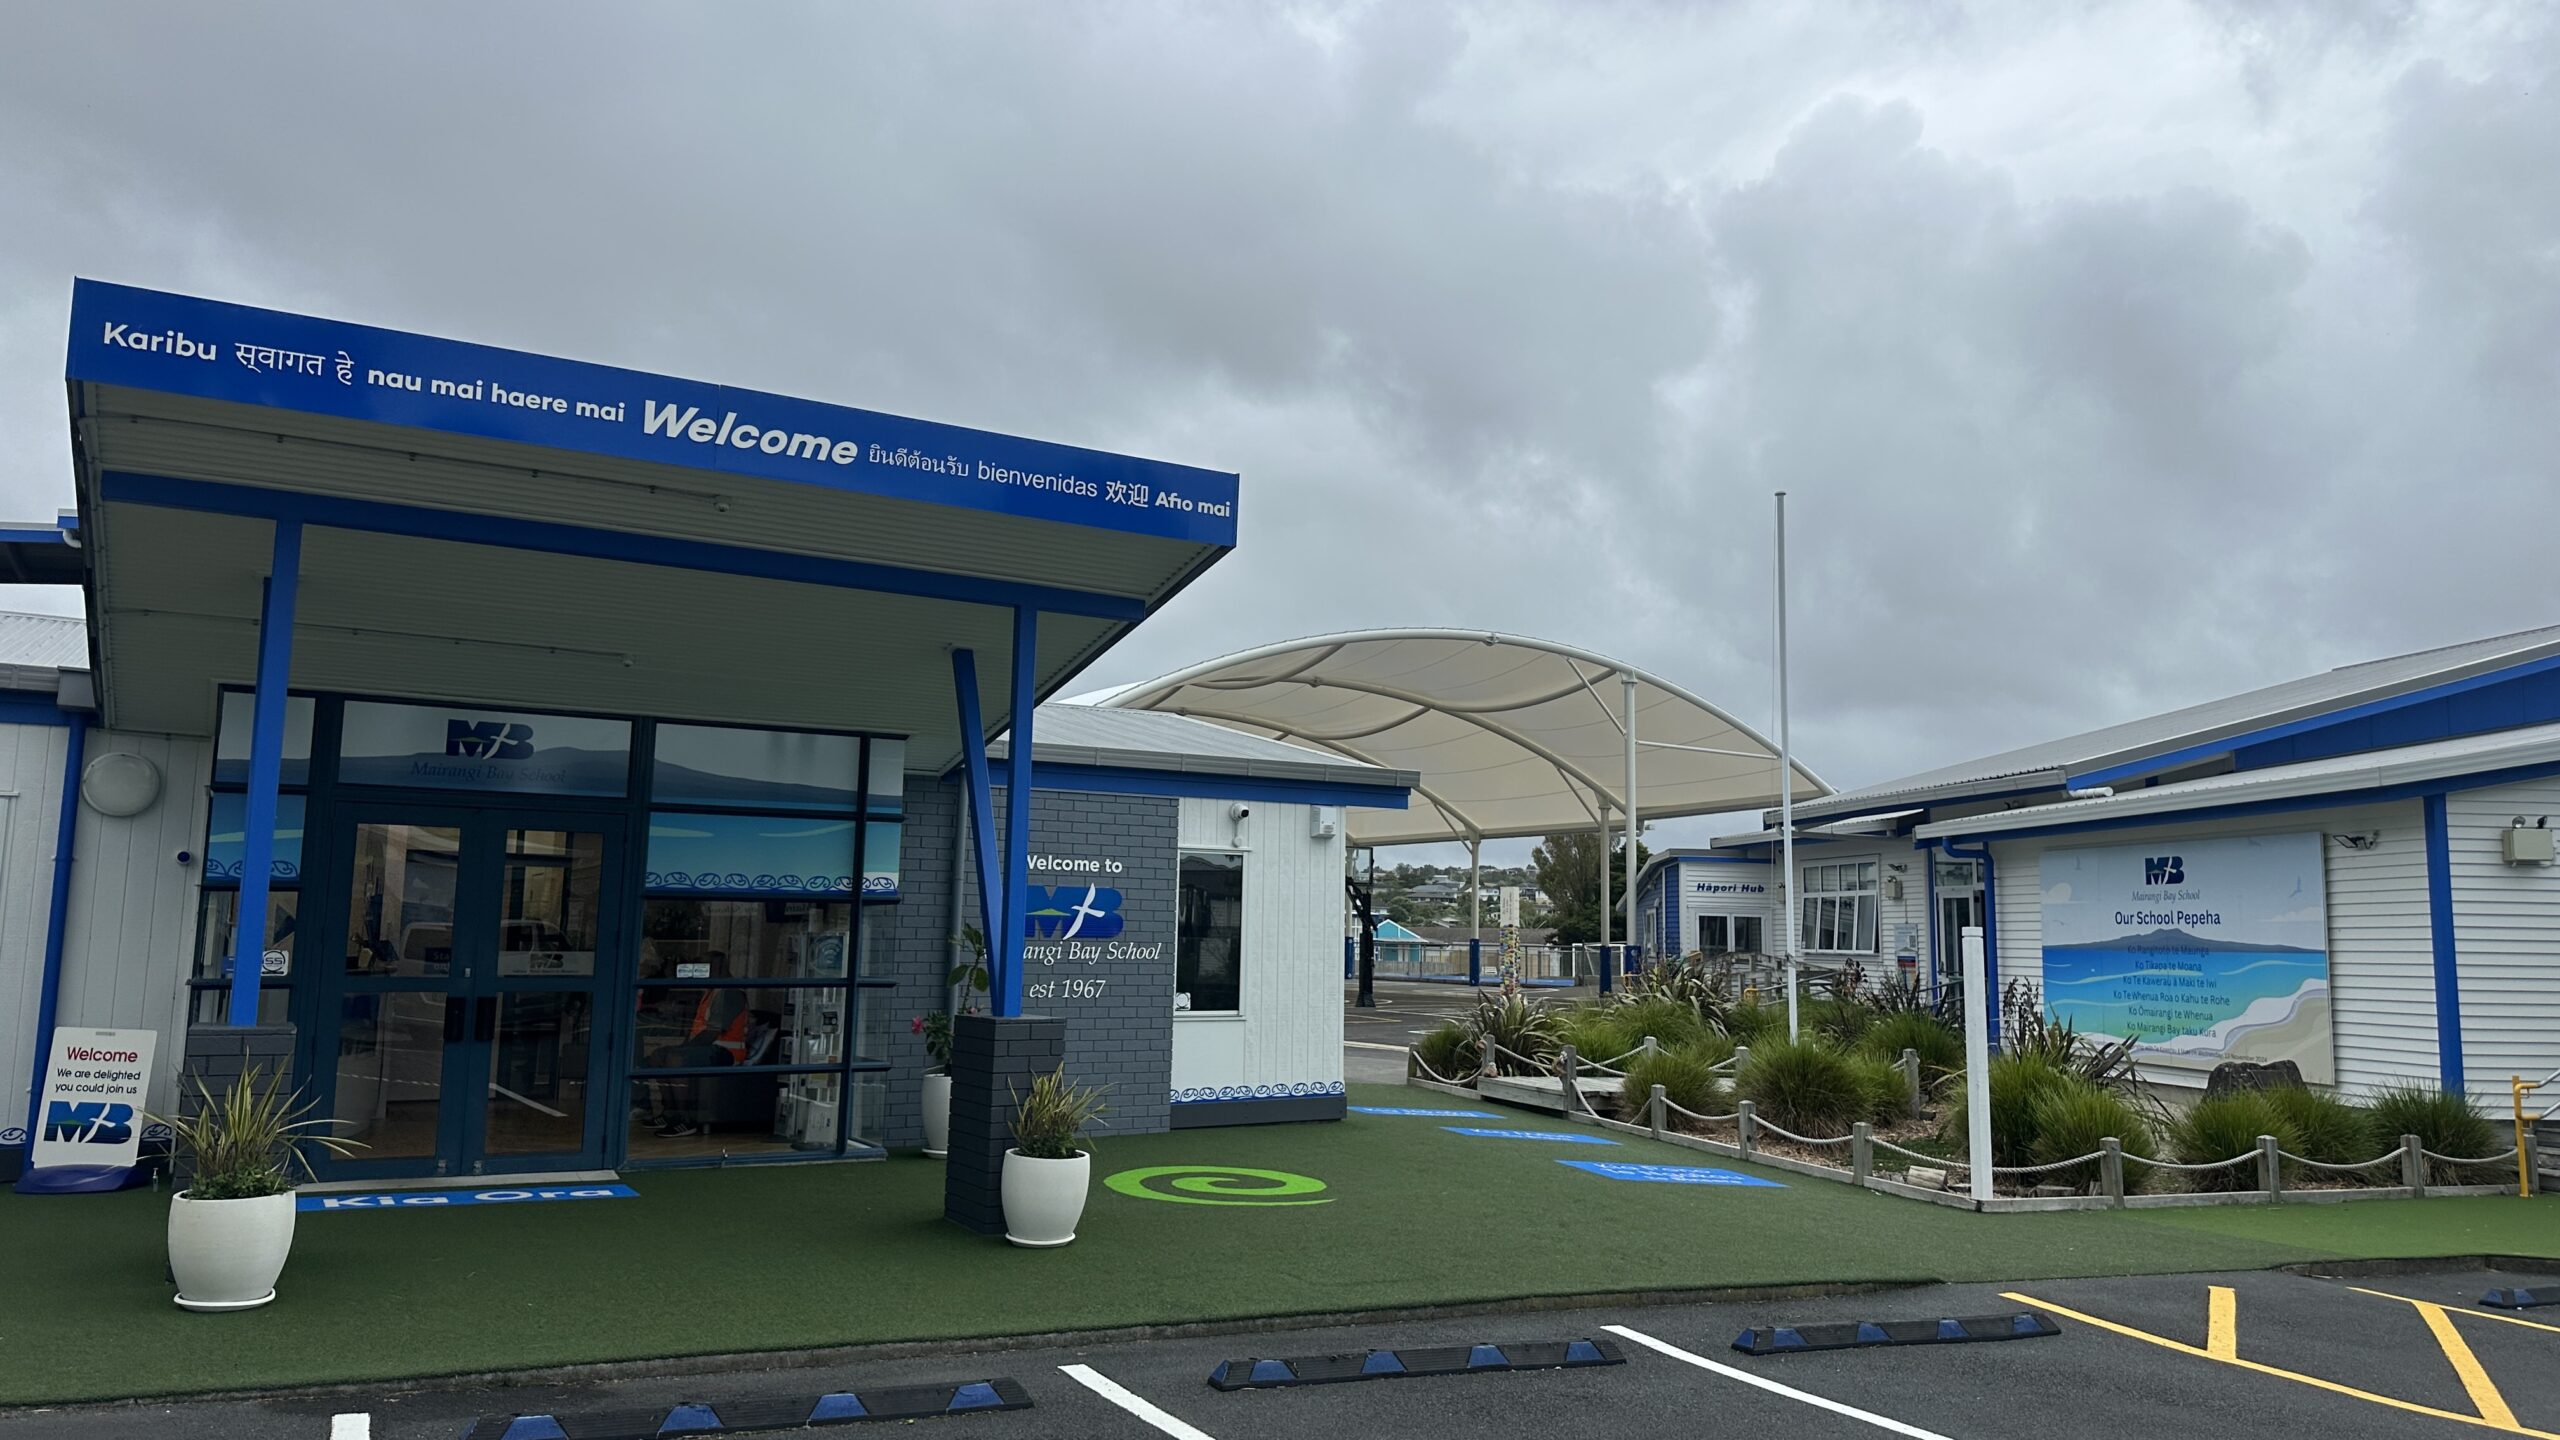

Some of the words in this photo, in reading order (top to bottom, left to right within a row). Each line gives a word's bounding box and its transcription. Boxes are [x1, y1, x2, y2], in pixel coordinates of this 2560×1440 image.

[103, 322, 217, 362] Karibu
[367, 367, 422, 392] nau
[430, 377, 484, 401] mai
[490, 382, 568, 415] haere
[575, 400, 626, 424] mai
[642, 399, 858, 466] Welcome
[869, 443, 969, 477] ยินดีต้อนรับ
[977, 460, 1098, 498] bienvenidas
[1105, 480, 1150, 508] 欢迎
[1155, 491, 1194, 513] Afio
[1197, 500, 1232, 519] mai
[410, 762, 482, 782] Mairangi
[486, 765, 514, 782] Bay
[519, 768, 567, 783] School
[1105, 858, 1122, 873] to
[1741, 884, 1765, 893] Hub
[2131, 890, 2162, 904] Mairangi
[2163, 890, 2176, 904] Bay
[2178, 889, 2200, 901] School
[2115, 911, 2135, 925] Our
[2137, 910, 2174, 925] School
[2176, 909, 2221, 928] Pepeha
[1068, 941, 1102, 965] Bay
[1106, 941, 1162, 960] School
[2135, 961, 2144, 970] Ko
[2168, 961, 2176, 970] te
[2177, 961, 2202, 972] Moana
[1029, 980, 1056, 998] est
[1062, 979, 1106, 998] 1967
[2123, 976, 2132, 984] Ko
[2133, 976, 2141, 985] Te
[2142, 976, 2171, 986] Kawerau
[2197, 978, 2205, 988] te
[2206, 979, 2217, 989] Iwi
[2113, 990, 2121, 999] Ko
[2123, 990, 2132, 999] Te
[2132, 991, 2159, 1001] Whenua
[2160, 992, 2173, 1002] Roa
[2181, 993, 2199, 1004] Kahu
[2200, 995, 2208, 1005] te
[2210, 995, 2230, 1006] Rohe
[2128, 1007, 2137, 1016] Ko
[2174, 1009, 2182, 1019] te
[2183, 1009, 2213, 1021] Whenua
[2127, 1022, 2135, 1031] Ko
[2136, 1022, 2166, 1035] Mairangi
[2167, 1024, 2180, 1036] Bay
[2182, 1026, 2197, 1036] taku
[67, 1046, 138, 1063] Welcome
[57, 1067, 73, 1078] We
[74, 1070, 91, 1079] are
[93, 1069, 141, 1082] delighted
[55, 1083, 73, 1093] you
[75, 1083, 104, 1093] could
[105, 1083, 124, 1095] join
[126, 1086, 137, 1094] us
[322, 1196, 449, 1208] Kia
[474, 1188, 615, 1201] Ora
